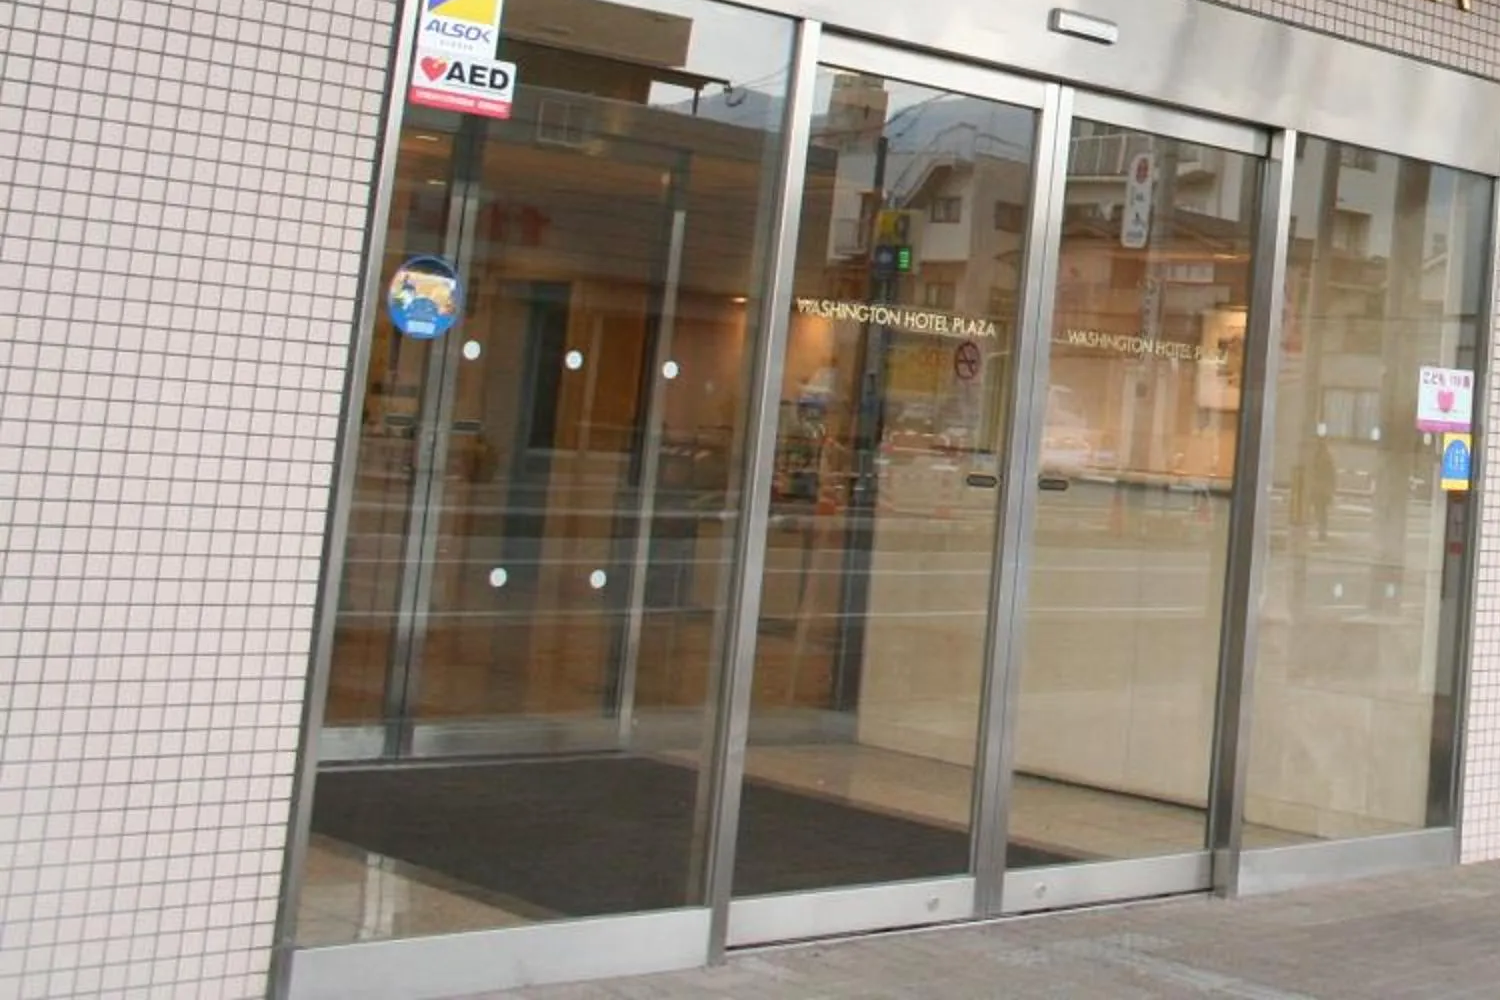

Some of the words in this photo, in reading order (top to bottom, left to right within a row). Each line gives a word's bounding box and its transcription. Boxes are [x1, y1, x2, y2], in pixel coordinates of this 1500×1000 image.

[425, 18, 492, 44] ALSOK
[446, 60, 510, 91] AED
[796, 297, 901, 326] WASHINGTON
[904, 310, 950, 333] HOTEL
[951, 317, 998, 338] PLAZA
